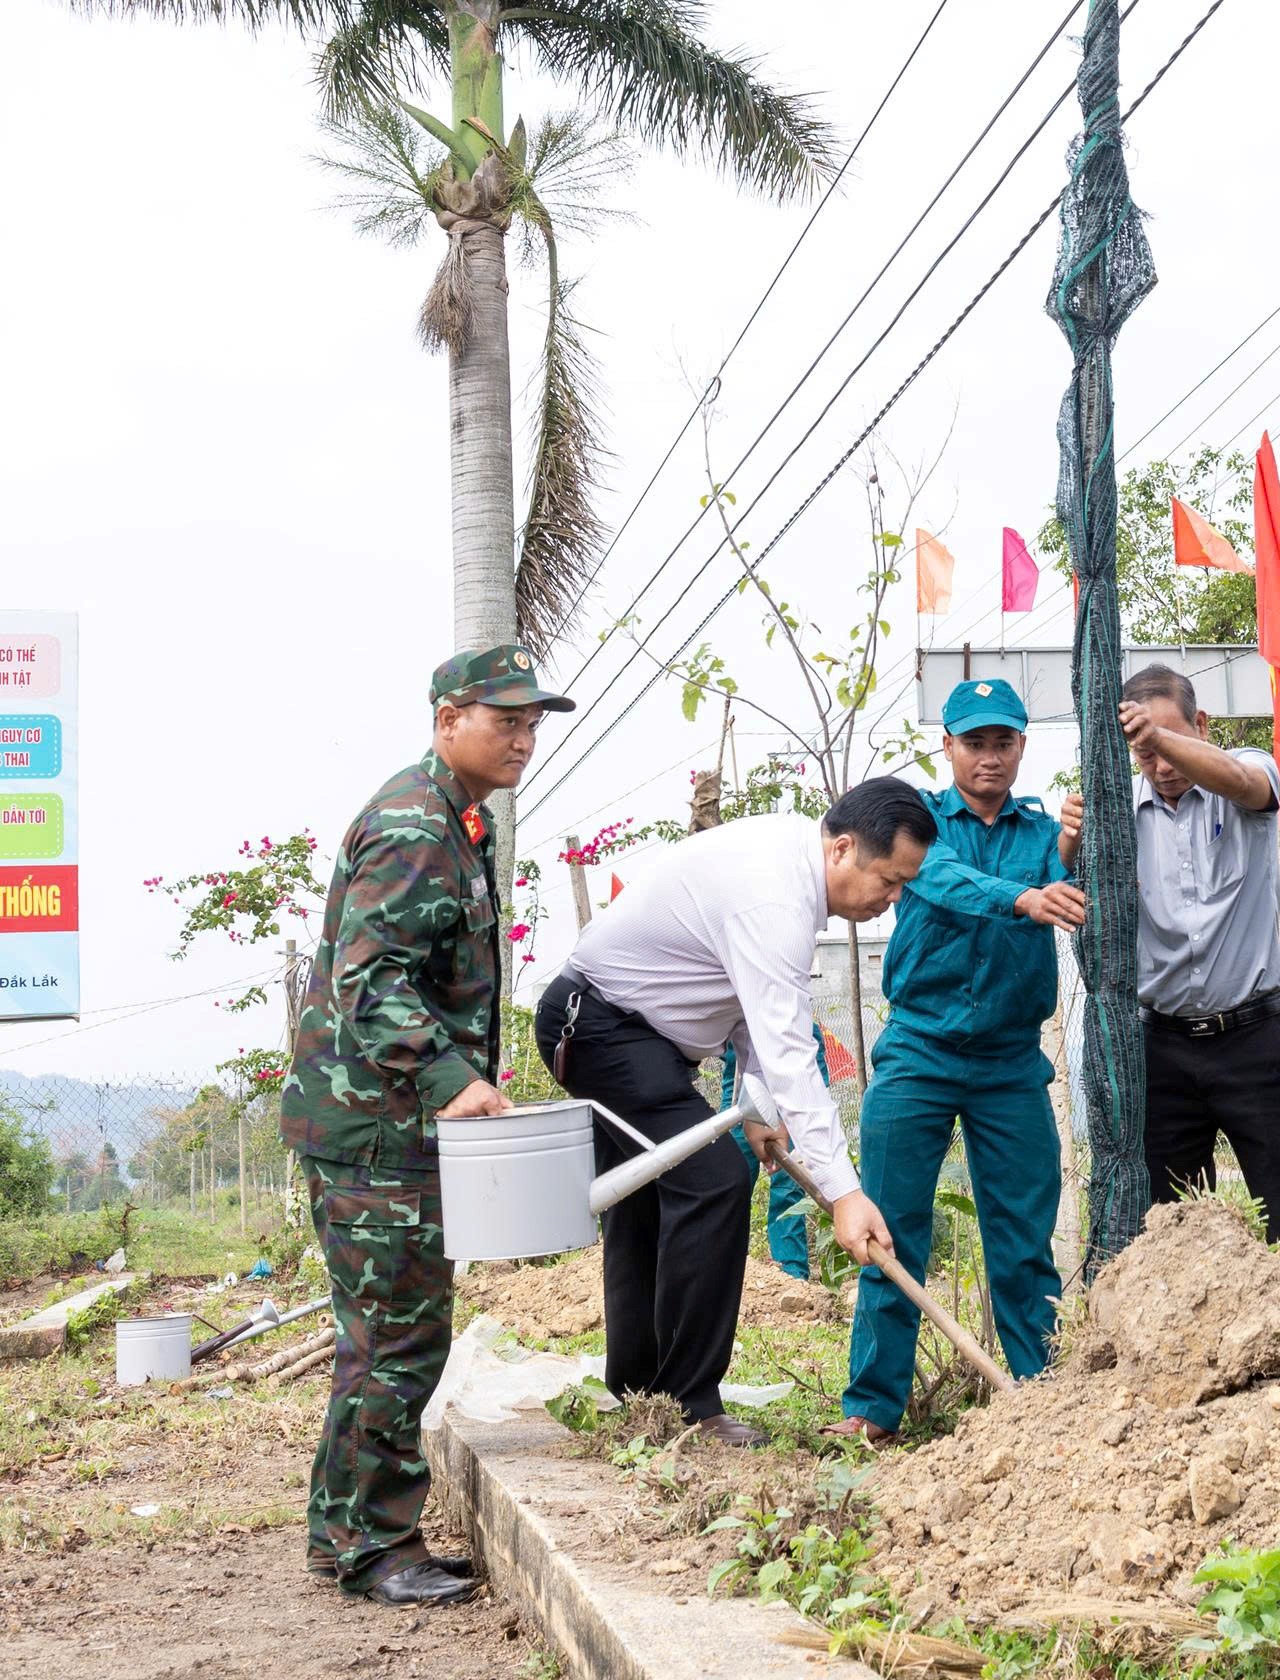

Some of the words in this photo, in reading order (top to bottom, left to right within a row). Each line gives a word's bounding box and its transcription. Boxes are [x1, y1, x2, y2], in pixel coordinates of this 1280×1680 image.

[12, 669, 31, 688] TẬT
[0, 729, 22, 743] GUY
[26, 728, 41, 743] CƠ
[5, 752, 29, 766] THAI
[29, 807, 46, 824] TỚI
[32, 973, 58, 987] Lắk
